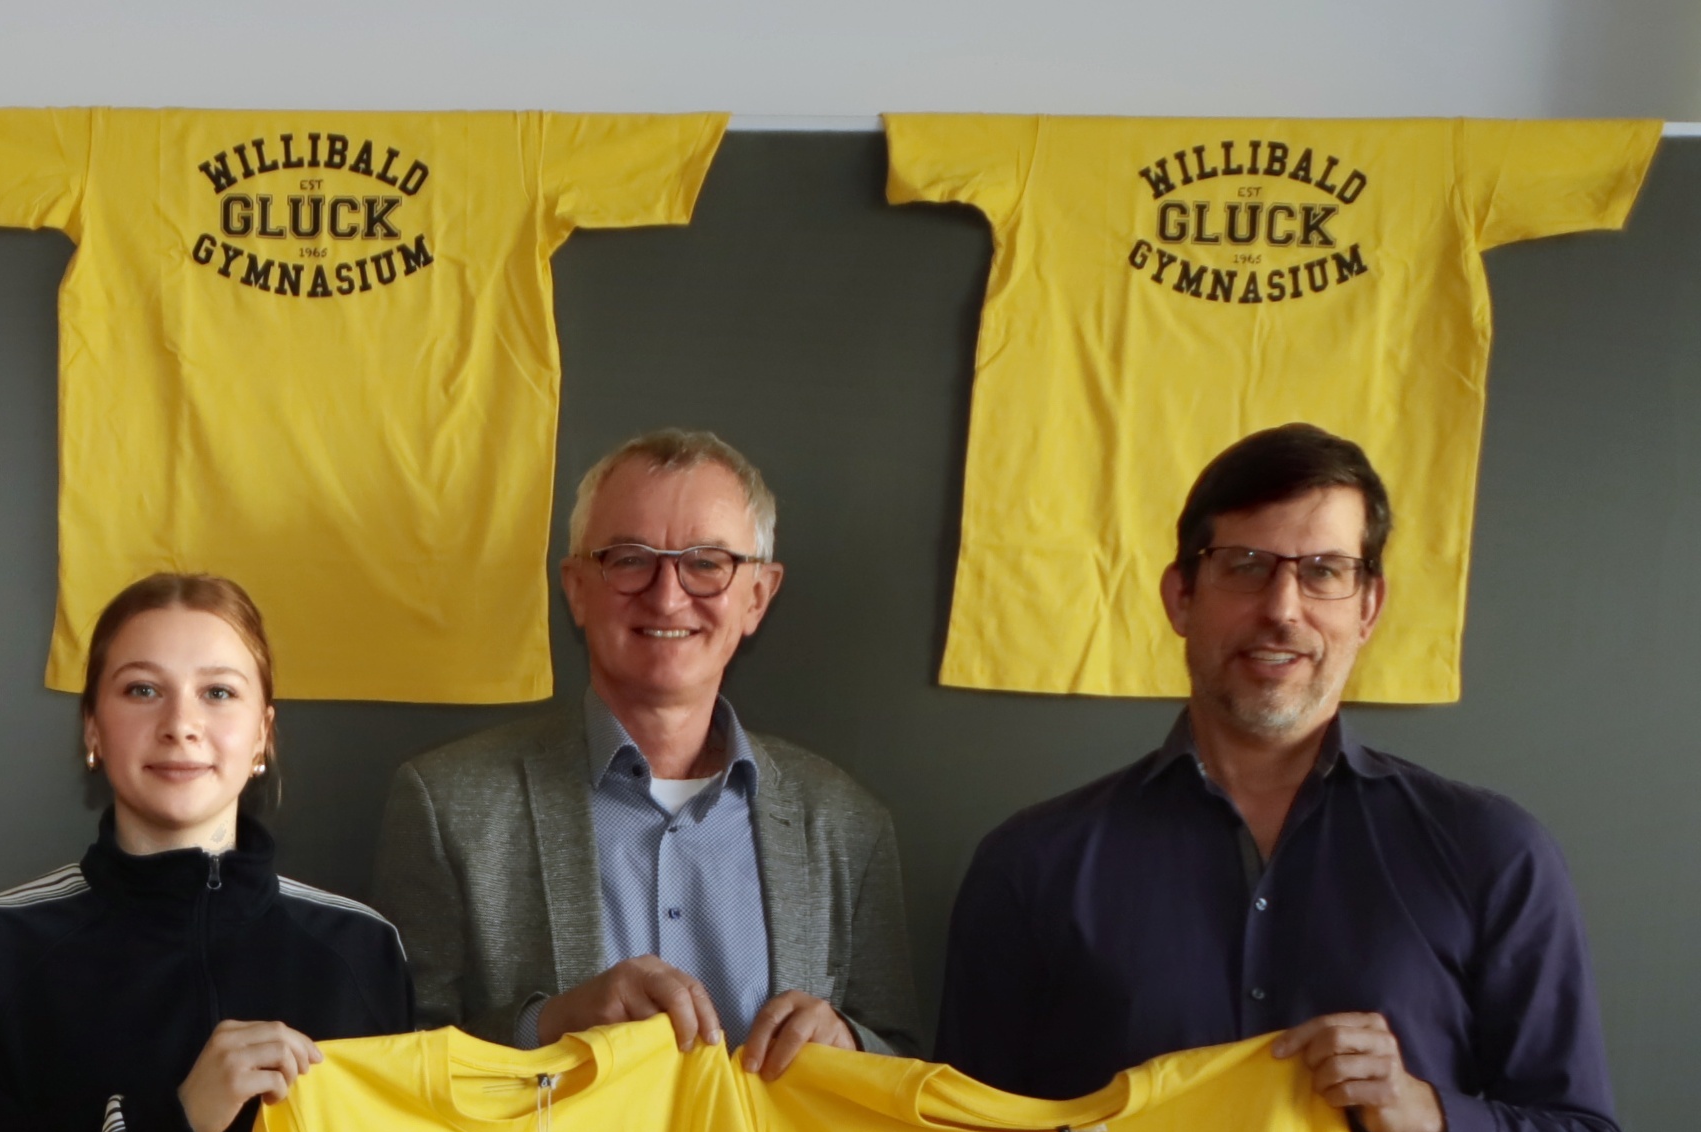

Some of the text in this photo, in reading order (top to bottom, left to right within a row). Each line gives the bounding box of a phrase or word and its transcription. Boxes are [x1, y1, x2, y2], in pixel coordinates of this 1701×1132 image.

[198, 132, 429, 196] WILLIBALD
[300, 179, 324, 191] EST
[1138, 140, 1367, 205] WILLIBALD
[220, 193, 402, 240] GLUCK
[1237, 187, 1262, 198] EST
[1156, 199, 1339, 248] GLUCK
[192, 233, 434, 298] GYMNASIUM
[1128, 239, 1368, 304] GYMNASIUM
